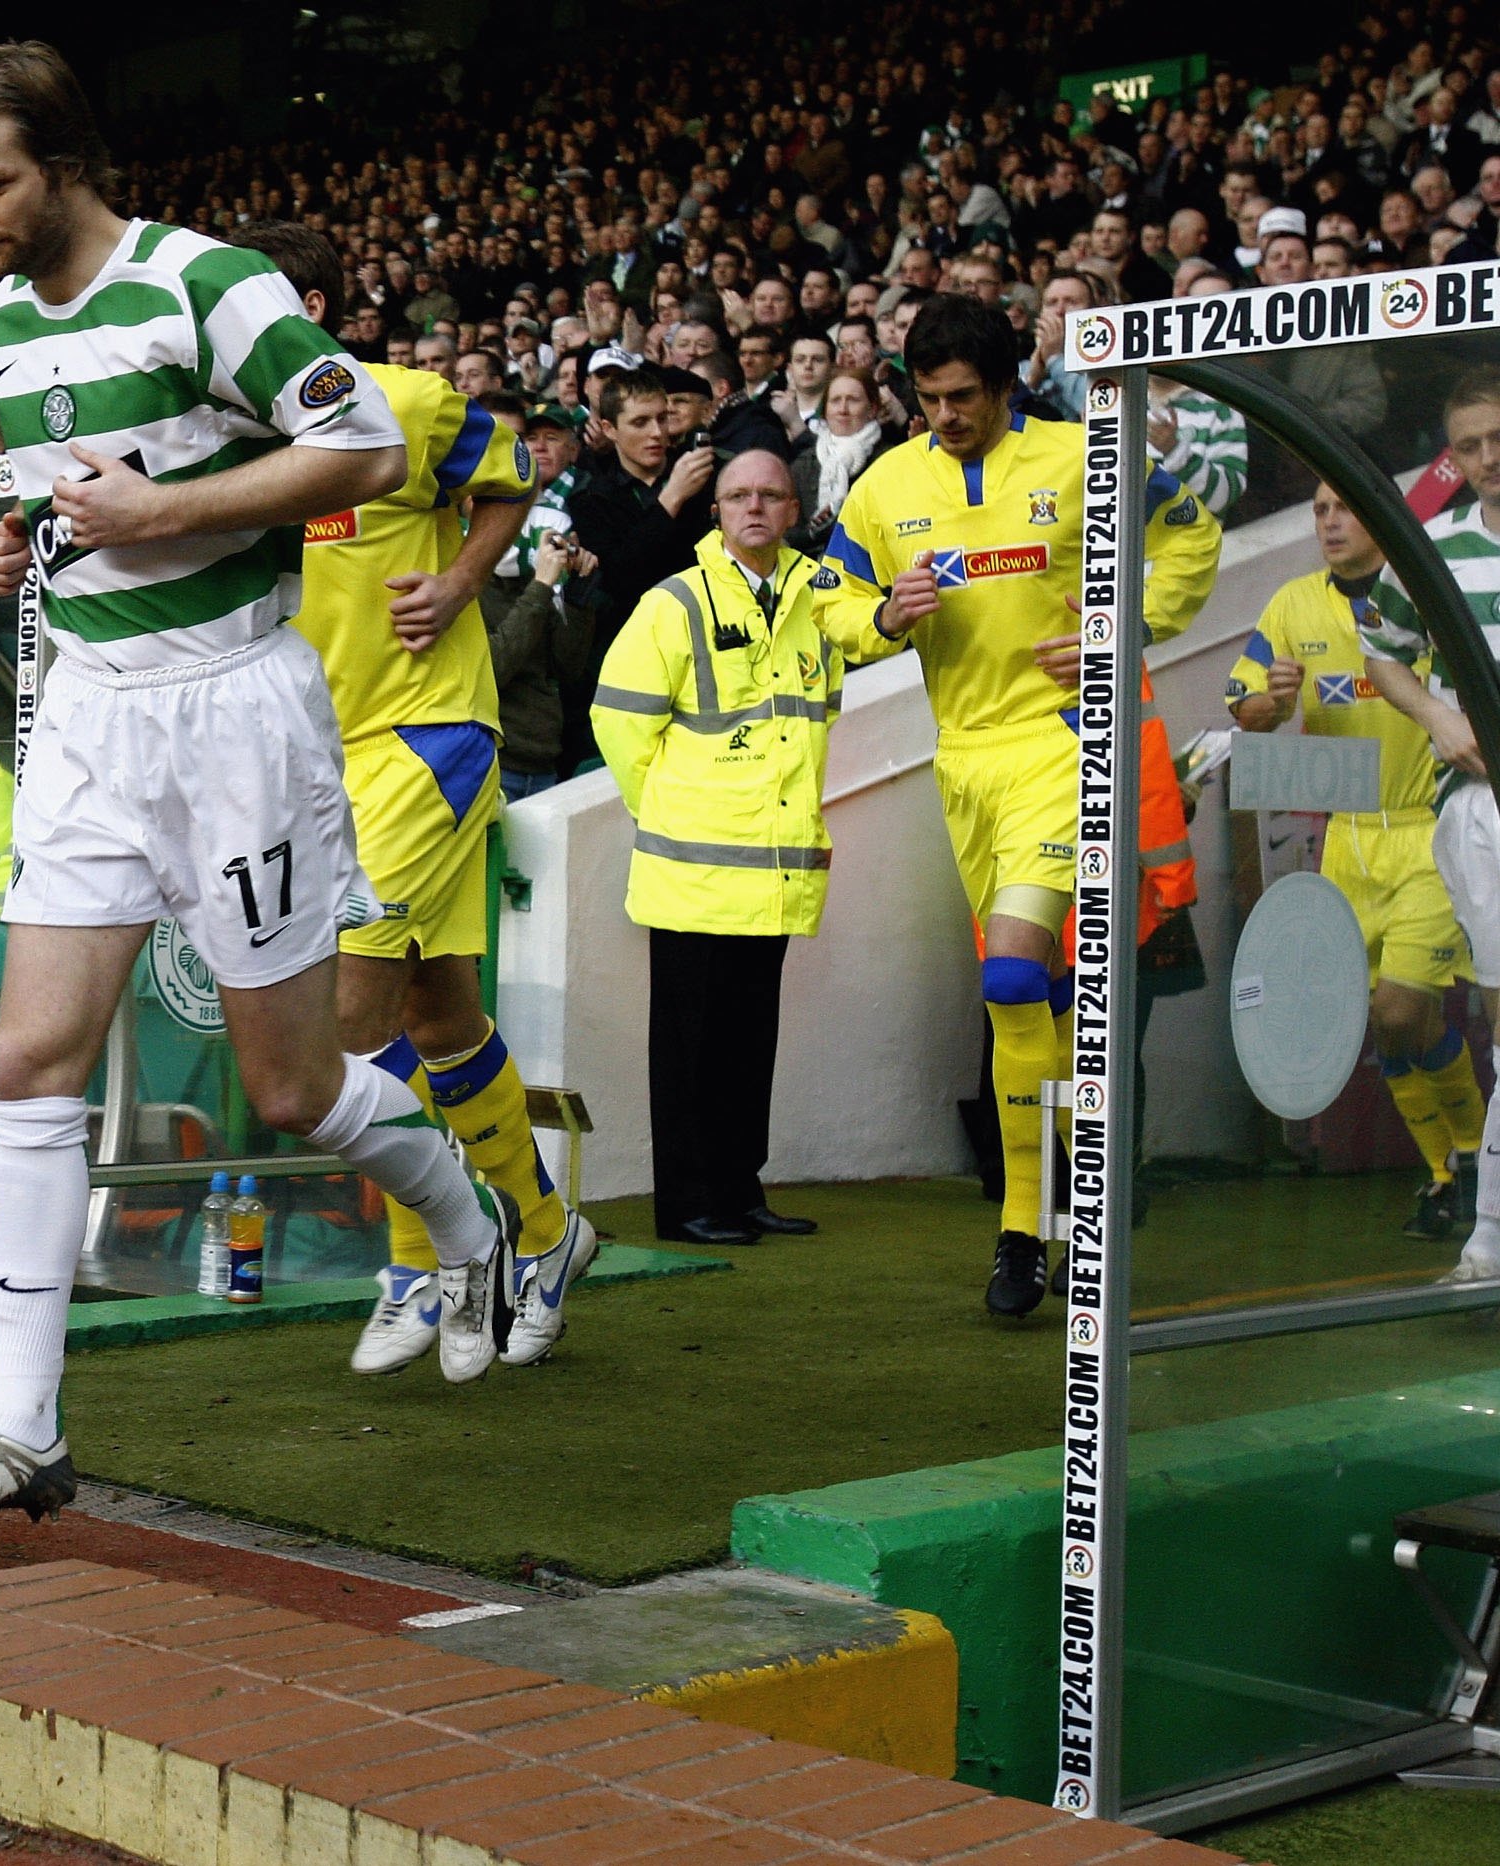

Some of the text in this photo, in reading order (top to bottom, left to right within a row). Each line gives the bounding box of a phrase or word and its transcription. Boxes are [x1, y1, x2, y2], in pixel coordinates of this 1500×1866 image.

[1083, 327, 1108, 349] 24
[1123, 283, 1371, 361] BET24.COM
[1389, 292, 1420, 314] 24
[1435, 266, 1500, 327] BE
[0, 469, 13, 483] 24
[1085, 416, 1118, 607] BET24.COM
[966, 552, 1041, 575] Galloway
[1093, 618, 1105, 639] 24
[1081, 652, 1114, 842] BET24.COM
[1088, 852, 1101, 874] 24
[222, 840, 292, 929] 17
[157, 918, 171, 951] THE
[1076, 887, 1110, 1077] BET24.COM
[1084, 1086, 1096, 1109] 24
[1071, 1119, 1105, 1309] BET24.COM
[1078, 1319, 1090, 1341] 24
[1066, 1352, 1099, 1543] BET24.COM
[1073, 1551, 1085, 1573] 24
[1061, 1583, 1094, 1777] BET24.COM
[1067, 1785, 1081, 1808] 24
